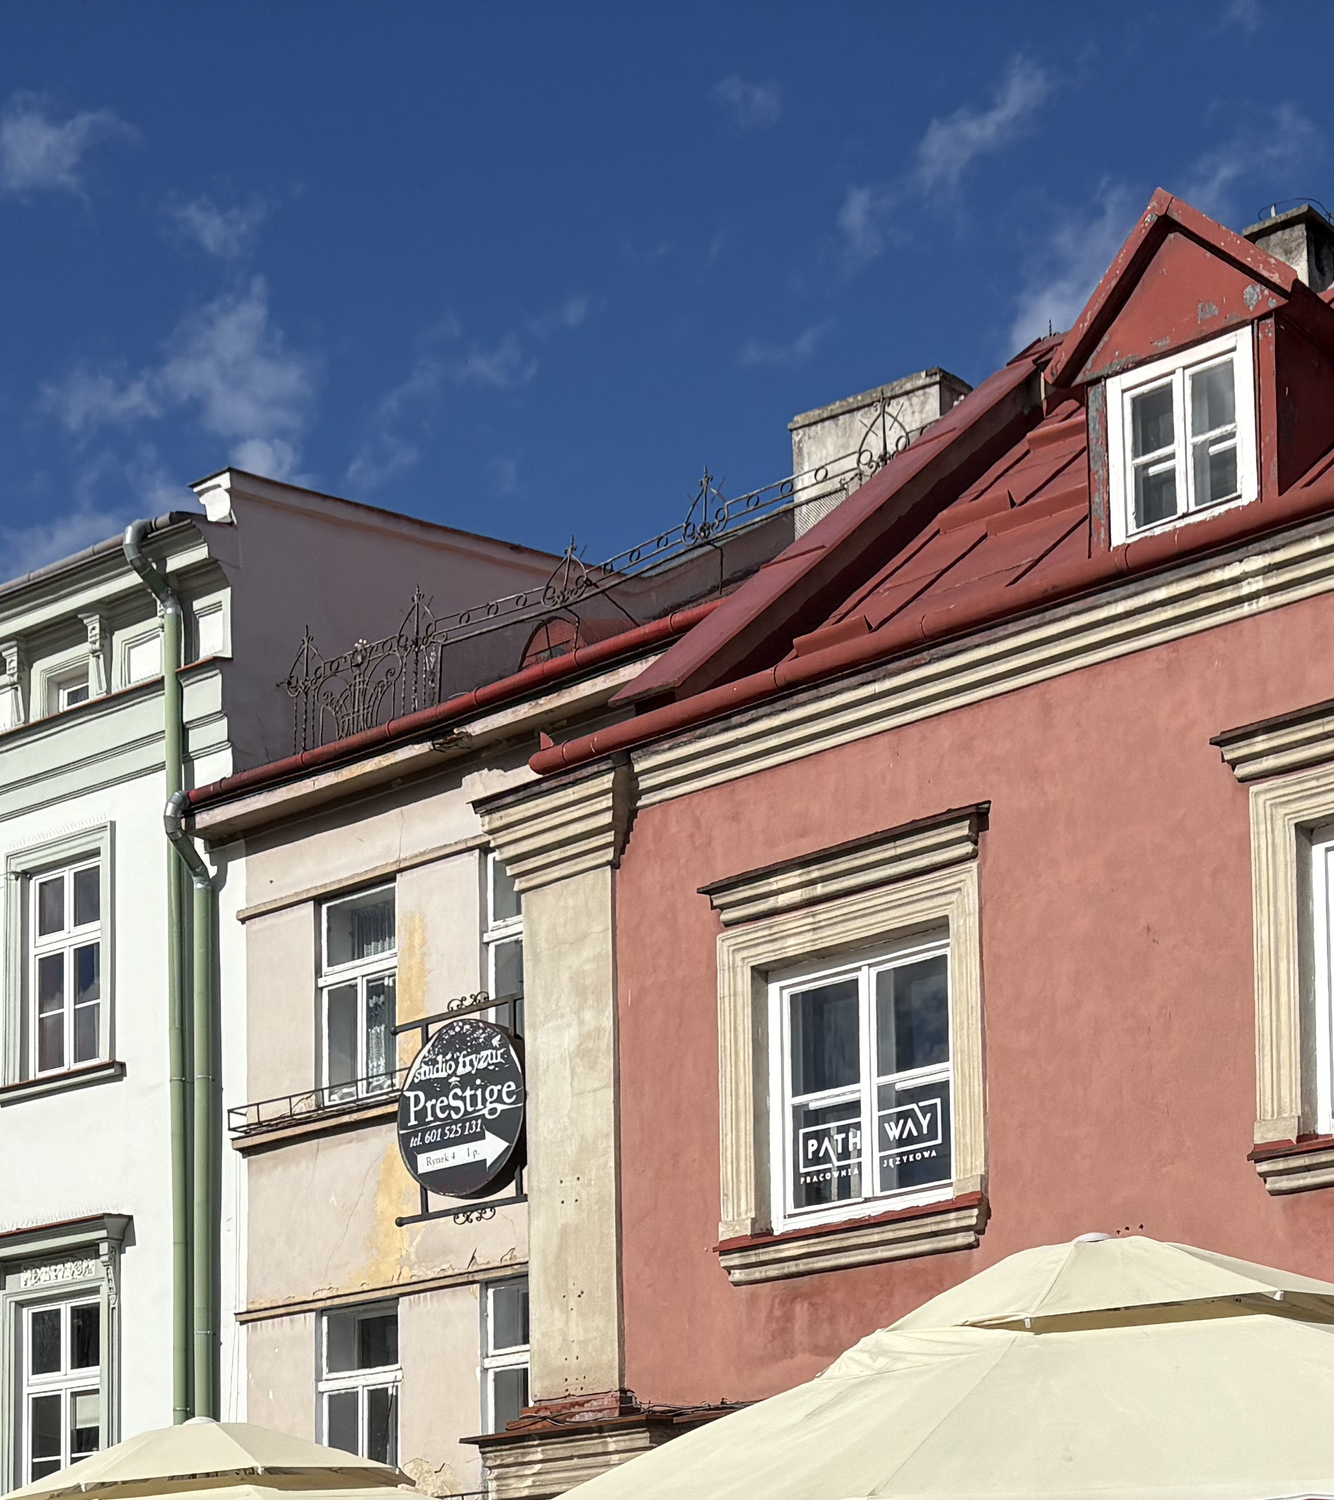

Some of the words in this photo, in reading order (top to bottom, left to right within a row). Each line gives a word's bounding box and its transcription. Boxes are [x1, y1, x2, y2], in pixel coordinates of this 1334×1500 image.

[414, 1054, 455, 1083] studio
[457, 1048, 506, 1075] fryzur
[410, 1132, 423, 1148] tel.
[425, 1128, 442, 1144] 601
[444, 1123, 462, 1140] 525
[464, 1118, 482, 1134] 131
[807, 1129, 862, 1159] PATH
[884, 1113, 932, 1141] WAY
[426, 1153, 449, 1167] Rynek
[800, 1167, 859, 1184] PRACOWNIA
[882, 1149, 937, 1168] JĘZYKOWA
